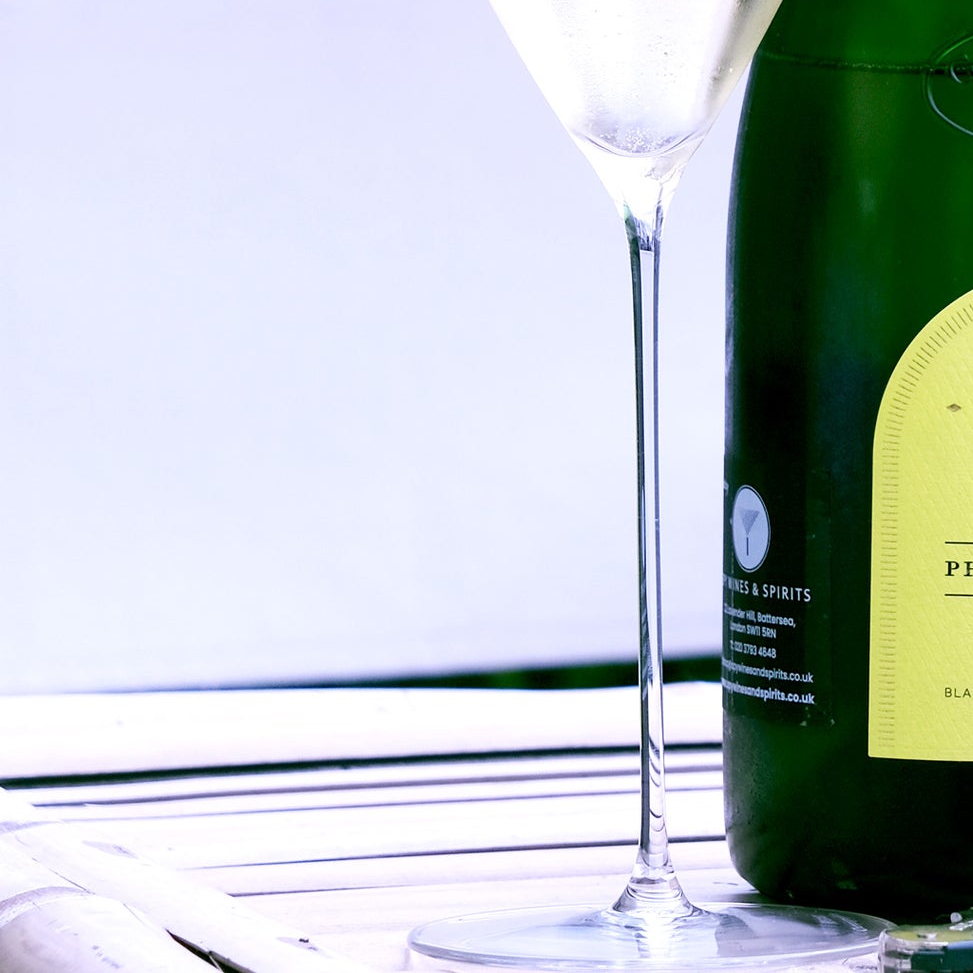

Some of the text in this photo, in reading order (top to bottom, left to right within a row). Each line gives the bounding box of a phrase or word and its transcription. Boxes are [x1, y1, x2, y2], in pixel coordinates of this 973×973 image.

[752, 582, 759, 596] &
[762, 583, 812, 603] SPIRITS
[757, 612, 796, 628] Battersea,
[762, 627, 777, 639] 5RN
